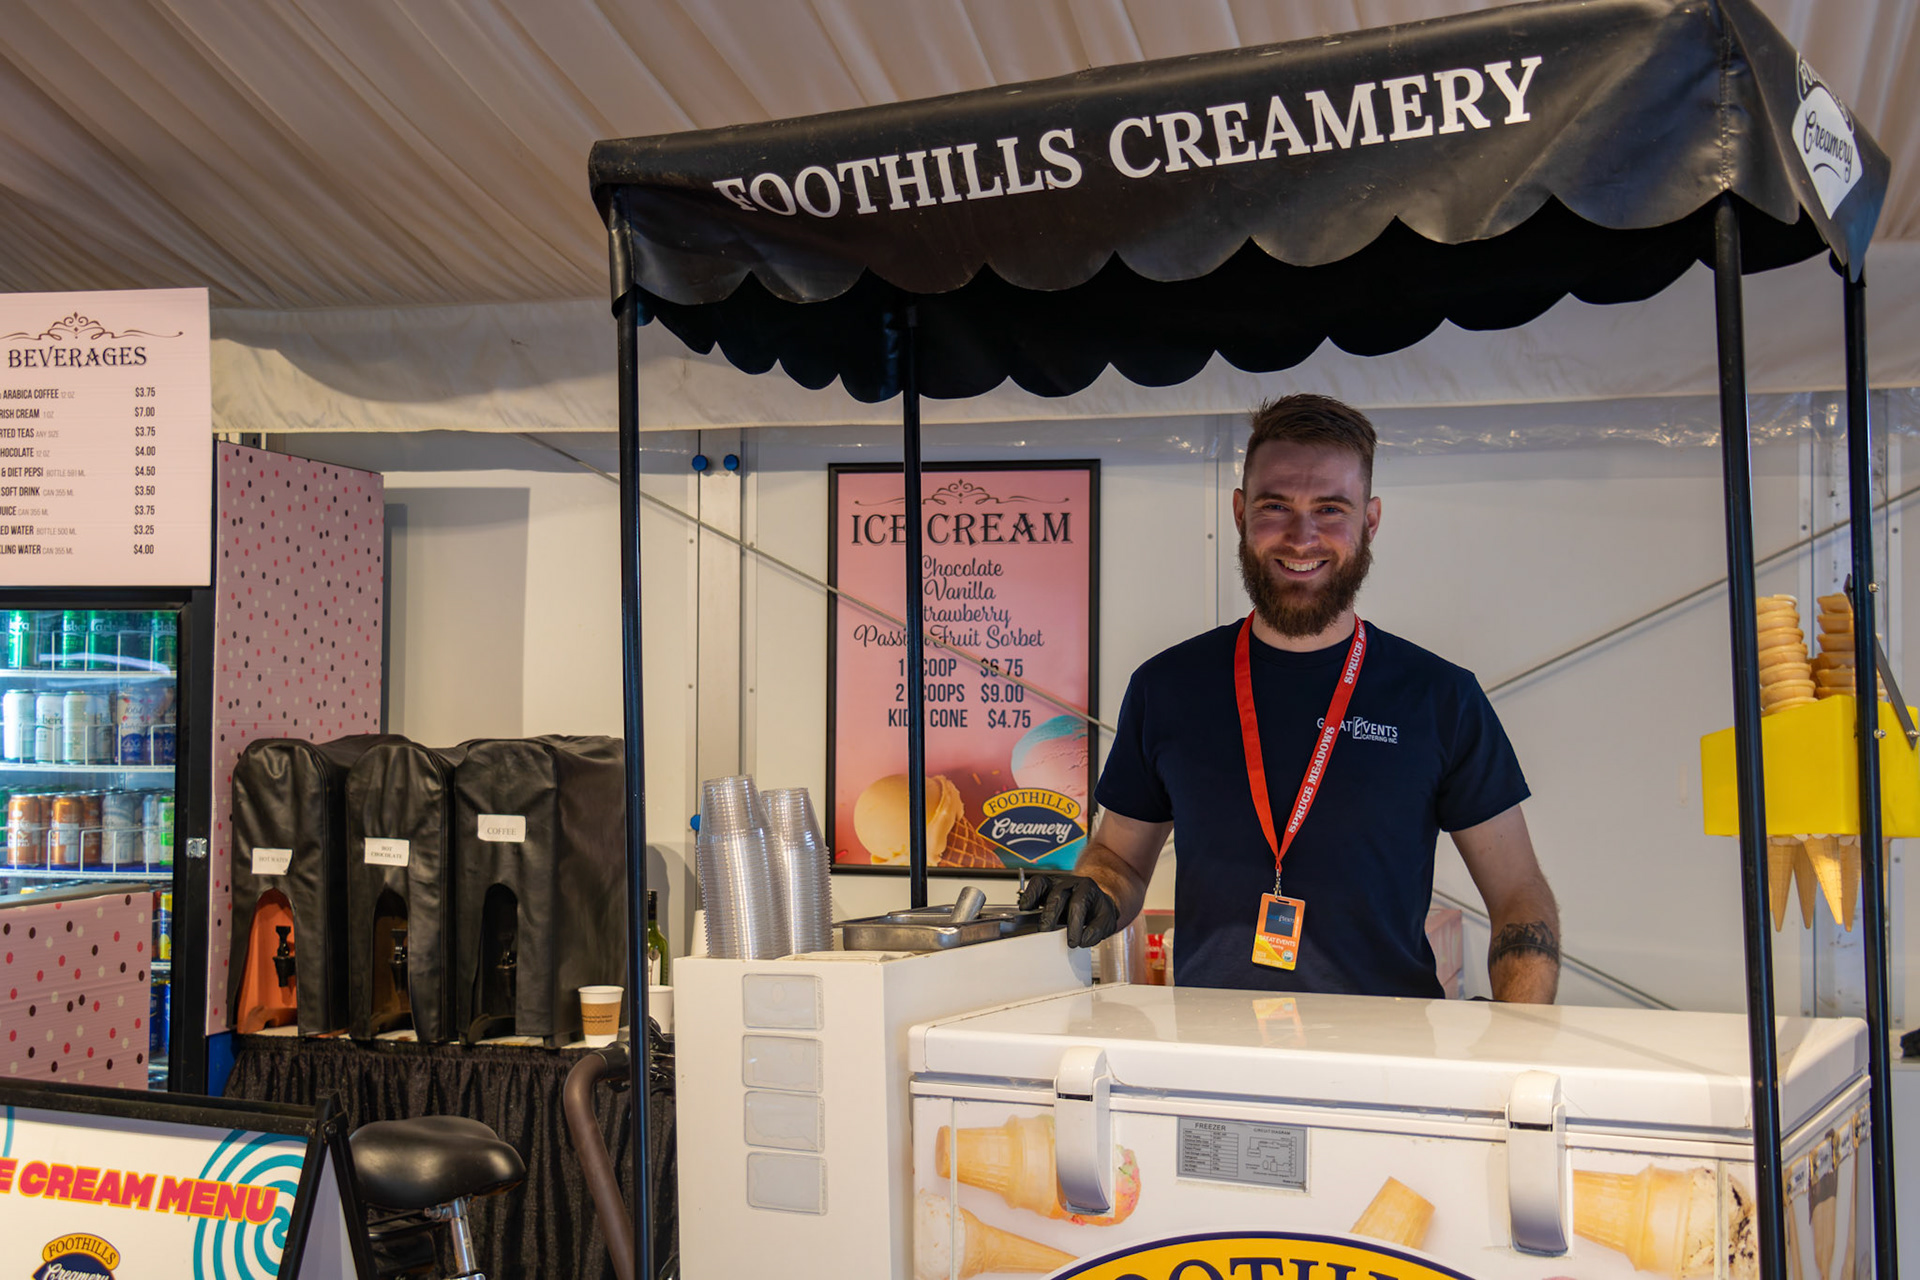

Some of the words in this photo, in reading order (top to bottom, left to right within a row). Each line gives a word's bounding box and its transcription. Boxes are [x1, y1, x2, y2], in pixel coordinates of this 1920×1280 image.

[712, 128, 1083, 219] FOOTHILLS
[1108, 56, 1543, 179] CREAMERY
[1803, 110, 1854, 183] Creamery
[8, 346, 147, 368] BEVERAGES
[3, 389, 33, 399] ARABICA
[34, 388, 59, 399] COFFEE
[135, 387, 156, 397] $3.75
[16, 408, 40, 418] CREAM
[135, 406, 156, 417] $7.00
[17, 428, 34, 438] TEAS
[135, 426, 156, 437] $3.75
[135, 446, 156, 456] $4.00
[7, 467, 23, 477] DIET
[24, 467, 43, 477] PEPSI
[135, 466, 156, 476] $4.50
[1, 486, 18, 496] SOFT
[19, 486, 40, 496] DRINK
[135, 485, 155, 496] $3.50
[134, 505, 155, 515] $3.75
[11, 525, 34, 535] WATER
[134, 524, 155, 535] $3.25
[851, 514, 906, 545] ICE
[926, 512, 1074, 547] CREAM
[18, 544, 41, 554] WATER
[133, 544, 155, 555] $4.00
[922, 555, 1003, 579] Chocolate
[924, 577, 996, 601] Vanilla
[922, 603, 1012, 628] trawberry
[930, 624, 981, 649] Fruit
[986, 624, 1045, 649] Sorbet
[898, 658, 905, 677] 1
[1344, 641, 1364, 684] SPRUCE
[895, 683, 905, 702] 2
[980, 682, 1024, 704] $9.00
[930, 709, 968, 728] CONE
[987, 708, 1031, 729] $4.75
[1316, 717, 1353, 732] GAT
[1353, 716, 1398, 738] EVENTS
[1361, 733, 1388, 743] CATERING
[1288, 785, 1314, 834] SPRUCE
[1307, 726, 1335, 786] MEADOWS
[988, 791, 1075, 815] FOOTHILLS
[487, 827, 517, 835] COFFEE
[991, 817, 1073, 844] Creamery
[1194, 1122, 1226, 1131] FREEZER
[18, 1160, 158, 1211] CREAM
[155, 1175, 280, 1226] MENU
[47, 1236, 117, 1266] FOOTHILLS
